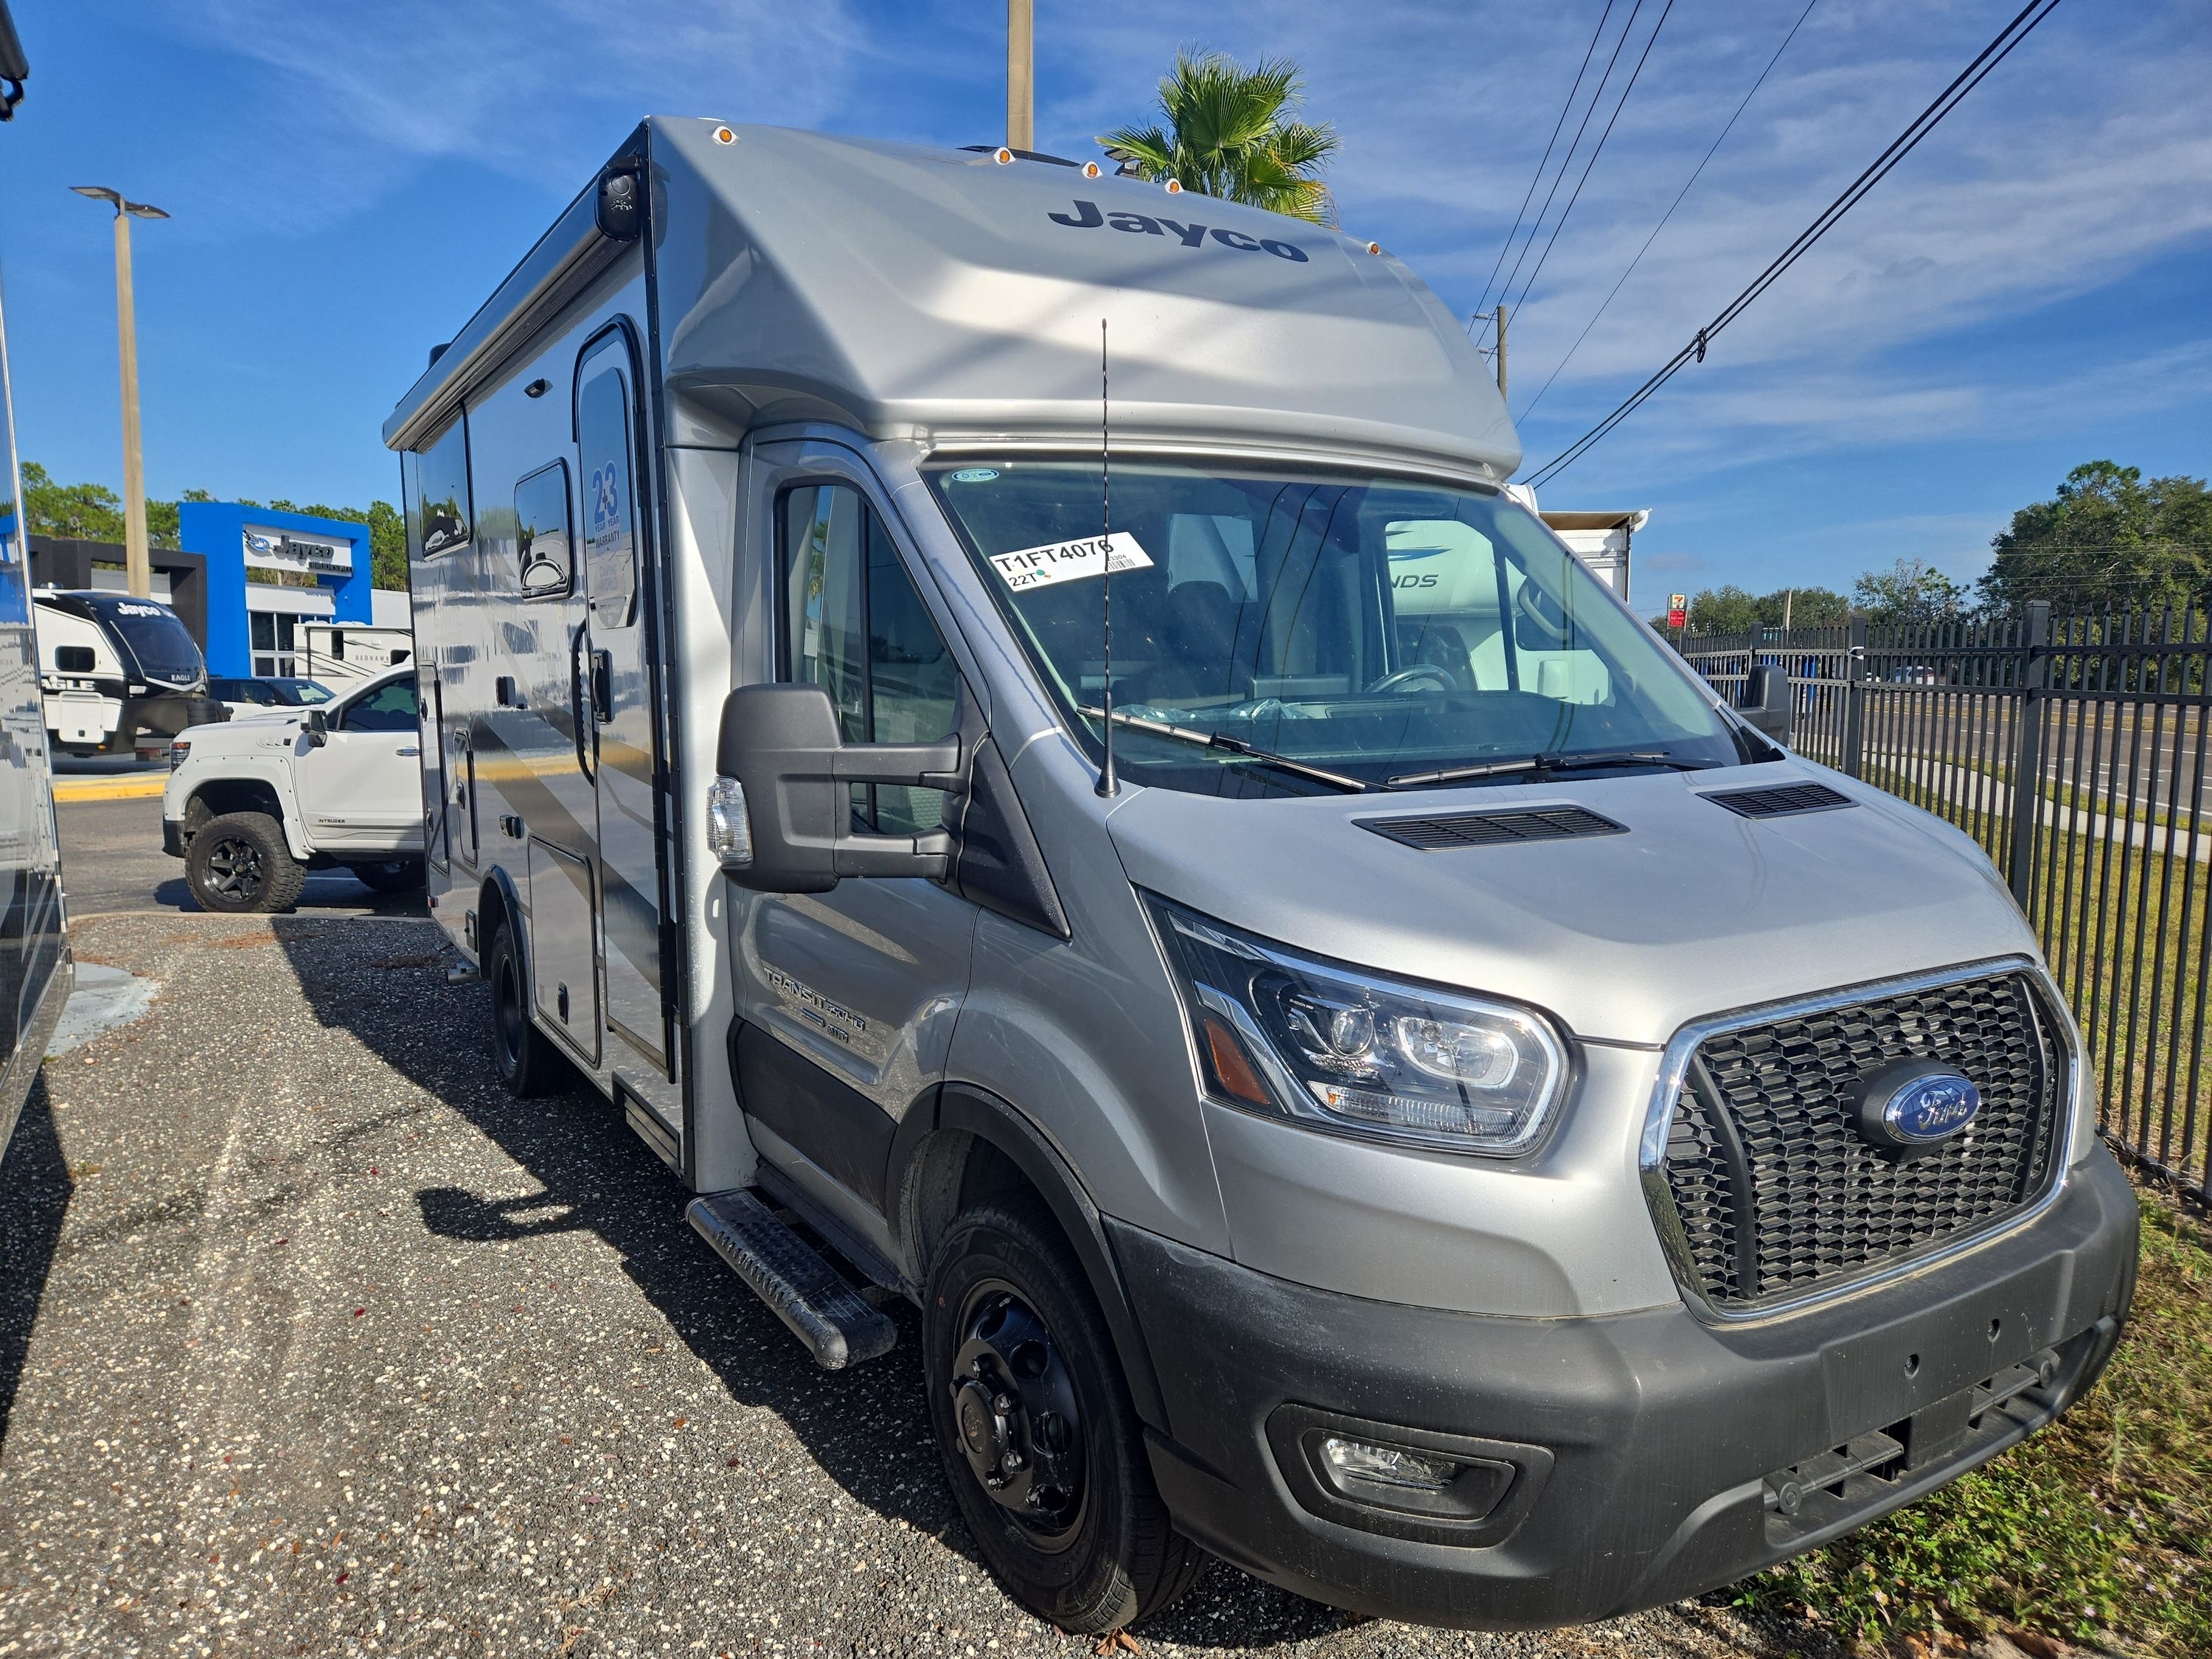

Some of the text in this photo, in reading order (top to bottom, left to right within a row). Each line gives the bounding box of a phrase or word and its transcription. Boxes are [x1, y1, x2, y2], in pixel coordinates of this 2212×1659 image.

[1047, 199, 1310, 262] Jayco
[595, 515, 619, 533] YEAR YEAR
[274, 535, 334, 560] Jayco
[596, 529, 620, 549] WARRANTY
[995, 539, 1114, 572] T1FT4076
[118, 602, 161, 618] Jayco
[171, 674, 190, 682] EAGLE
[763, 967, 827, 1009] TRANSIT
[1917, 1087, 1968, 1129] Ford
